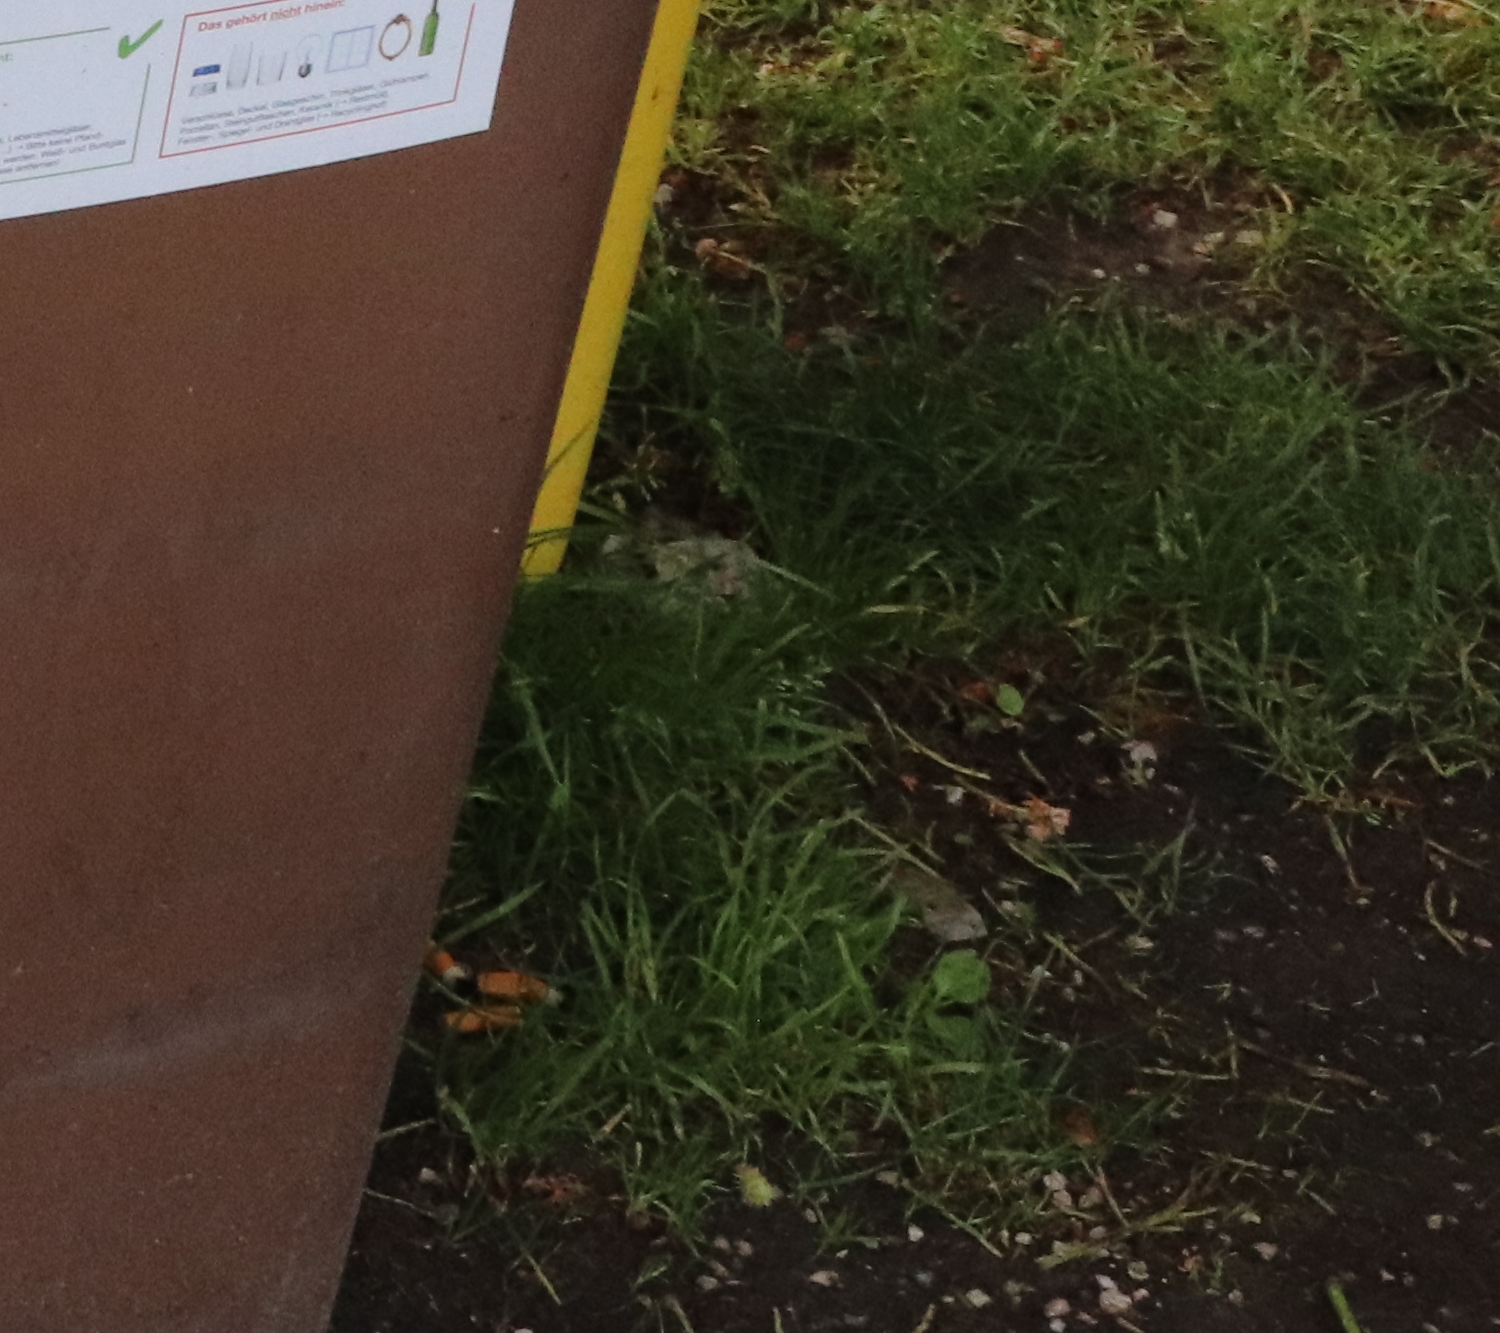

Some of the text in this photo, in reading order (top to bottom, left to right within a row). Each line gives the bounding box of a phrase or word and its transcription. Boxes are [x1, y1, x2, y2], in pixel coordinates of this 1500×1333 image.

[198, 0, 346, 32] Das gehört nicht hinein:
